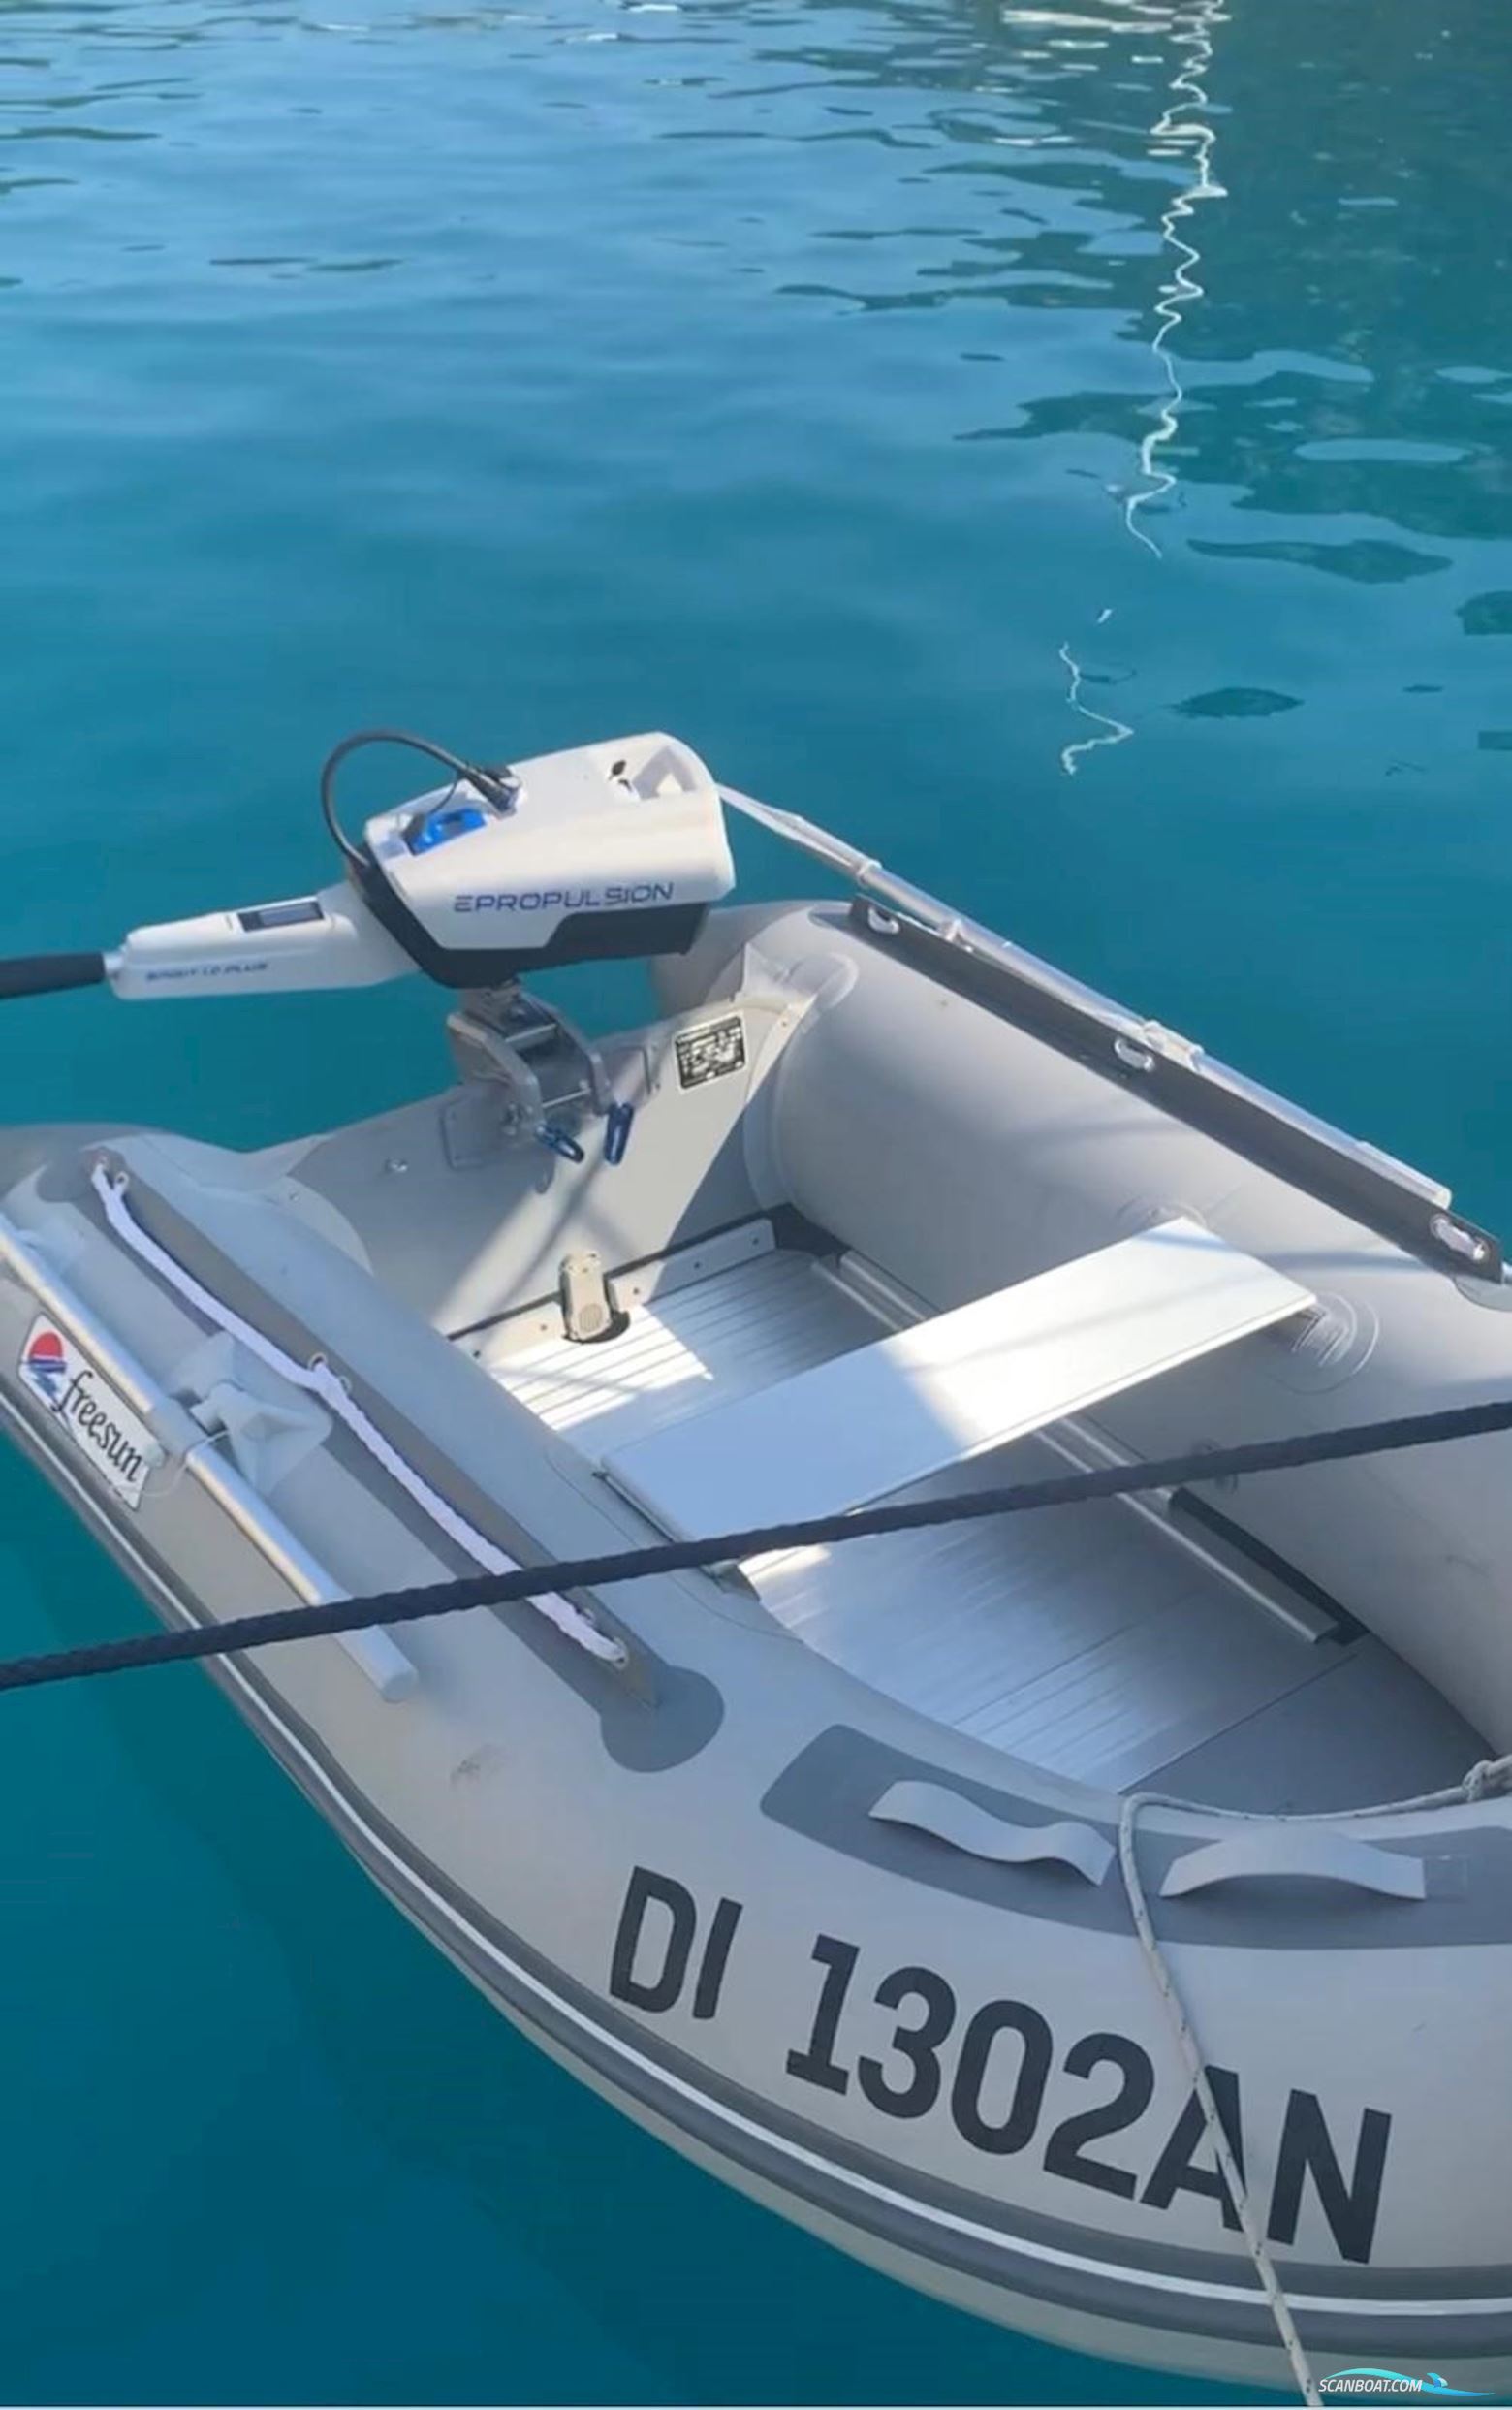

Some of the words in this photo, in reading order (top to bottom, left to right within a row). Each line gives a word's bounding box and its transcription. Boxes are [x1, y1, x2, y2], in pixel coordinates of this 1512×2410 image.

[454, 882, 675, 913] EPROPULSION
[50, 1370, 142, 1482] freesun
[609, 1865, 743, 2019] DI
[786, 1934, 1392, 2265] 1302AN
